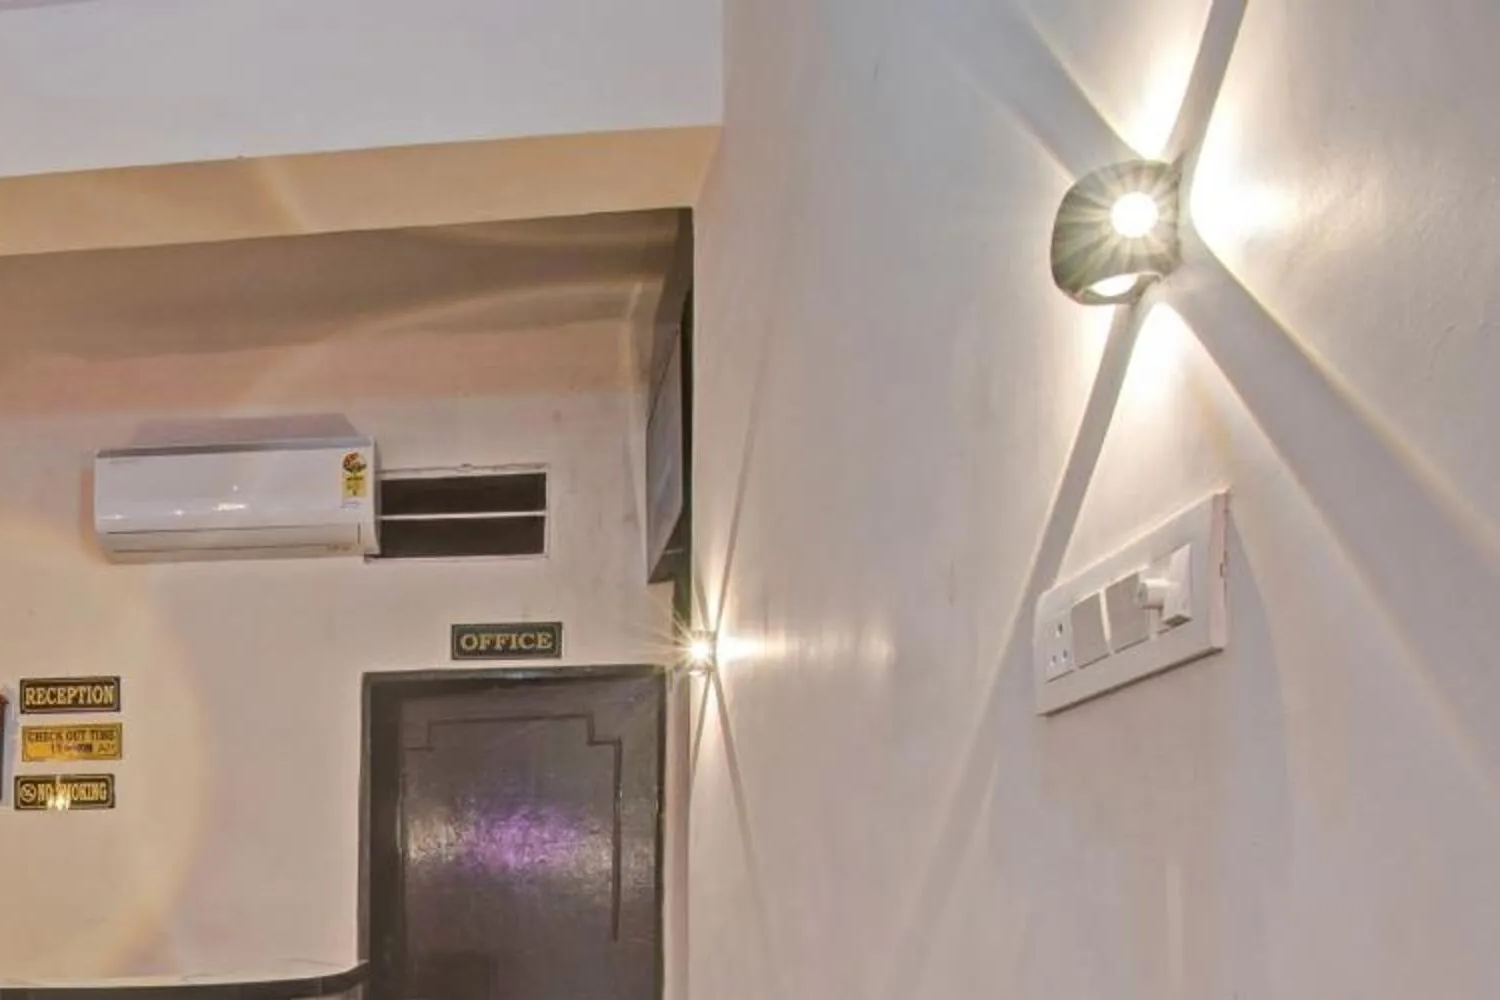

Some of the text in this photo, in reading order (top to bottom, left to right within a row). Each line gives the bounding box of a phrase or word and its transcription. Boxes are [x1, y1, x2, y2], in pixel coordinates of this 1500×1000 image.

[460, 632, 553, 651] OFFICE
[25, 684, 114, 705] RECEPTION
[27, 731, 63, 742] CHECK
[66, 730, 87, 741] OUT
[37, 783, 53, 801] NO
